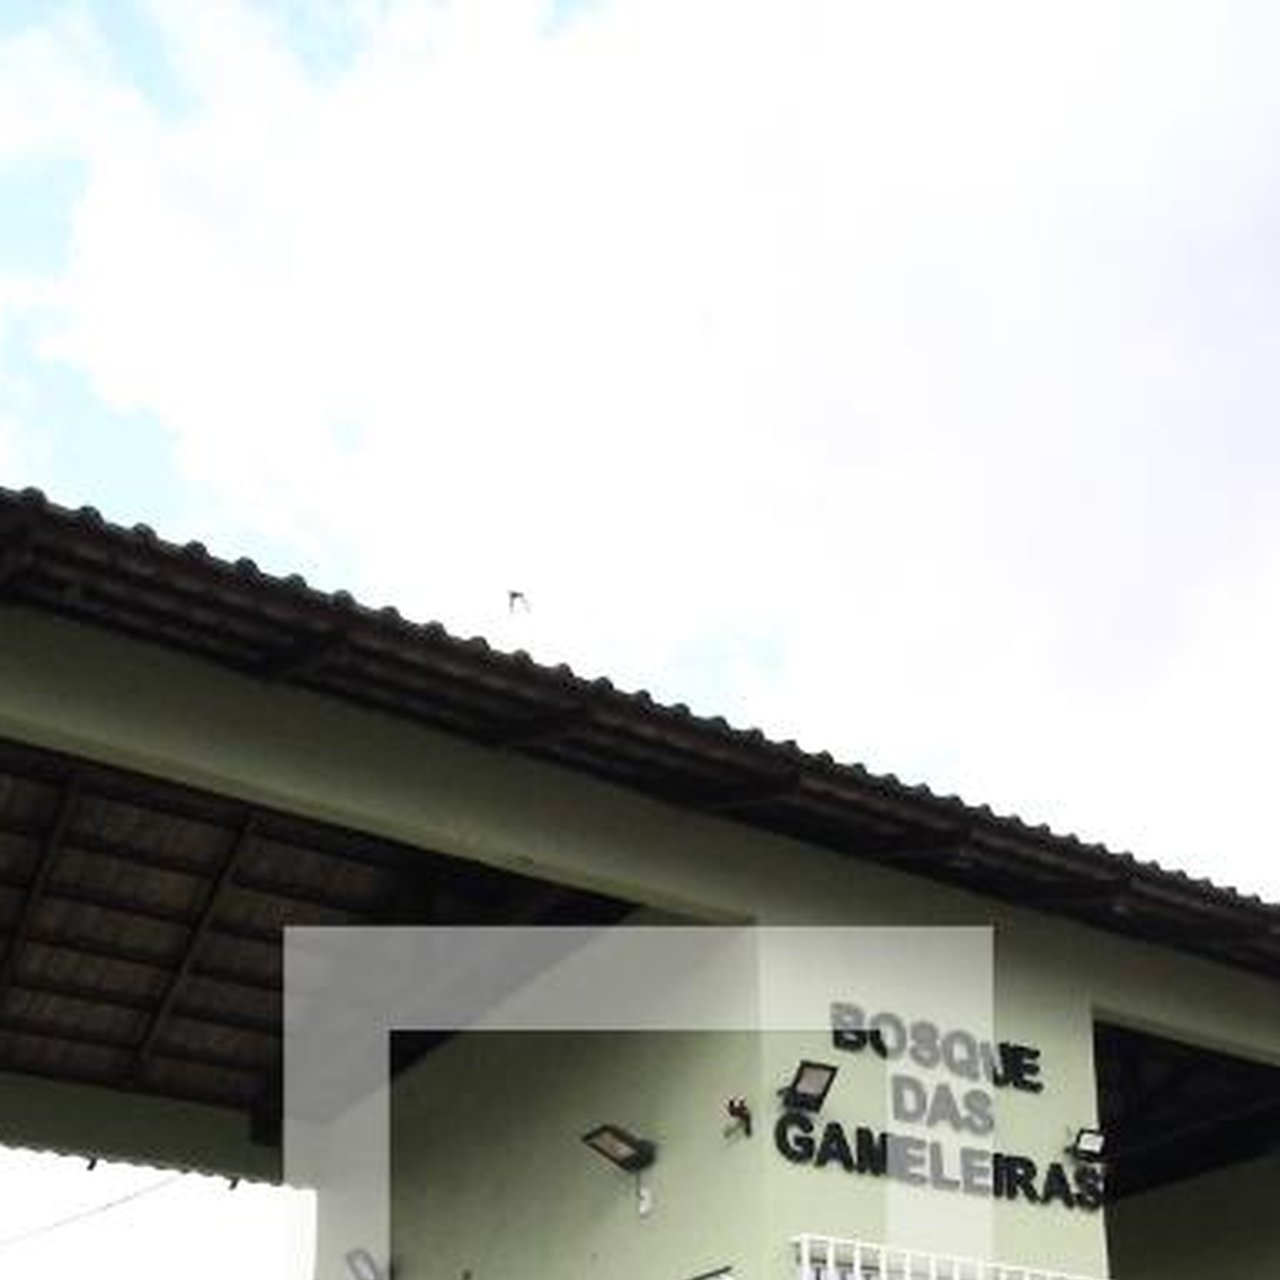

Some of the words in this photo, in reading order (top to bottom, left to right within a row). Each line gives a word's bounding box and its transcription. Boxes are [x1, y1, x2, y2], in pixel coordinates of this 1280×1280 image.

[829, 1001, 1044, 1094] BOSQUE
[890, 1073, 995, 1136] DAS
[774, 1111, 1106, 1211] GAMELEIRAS
